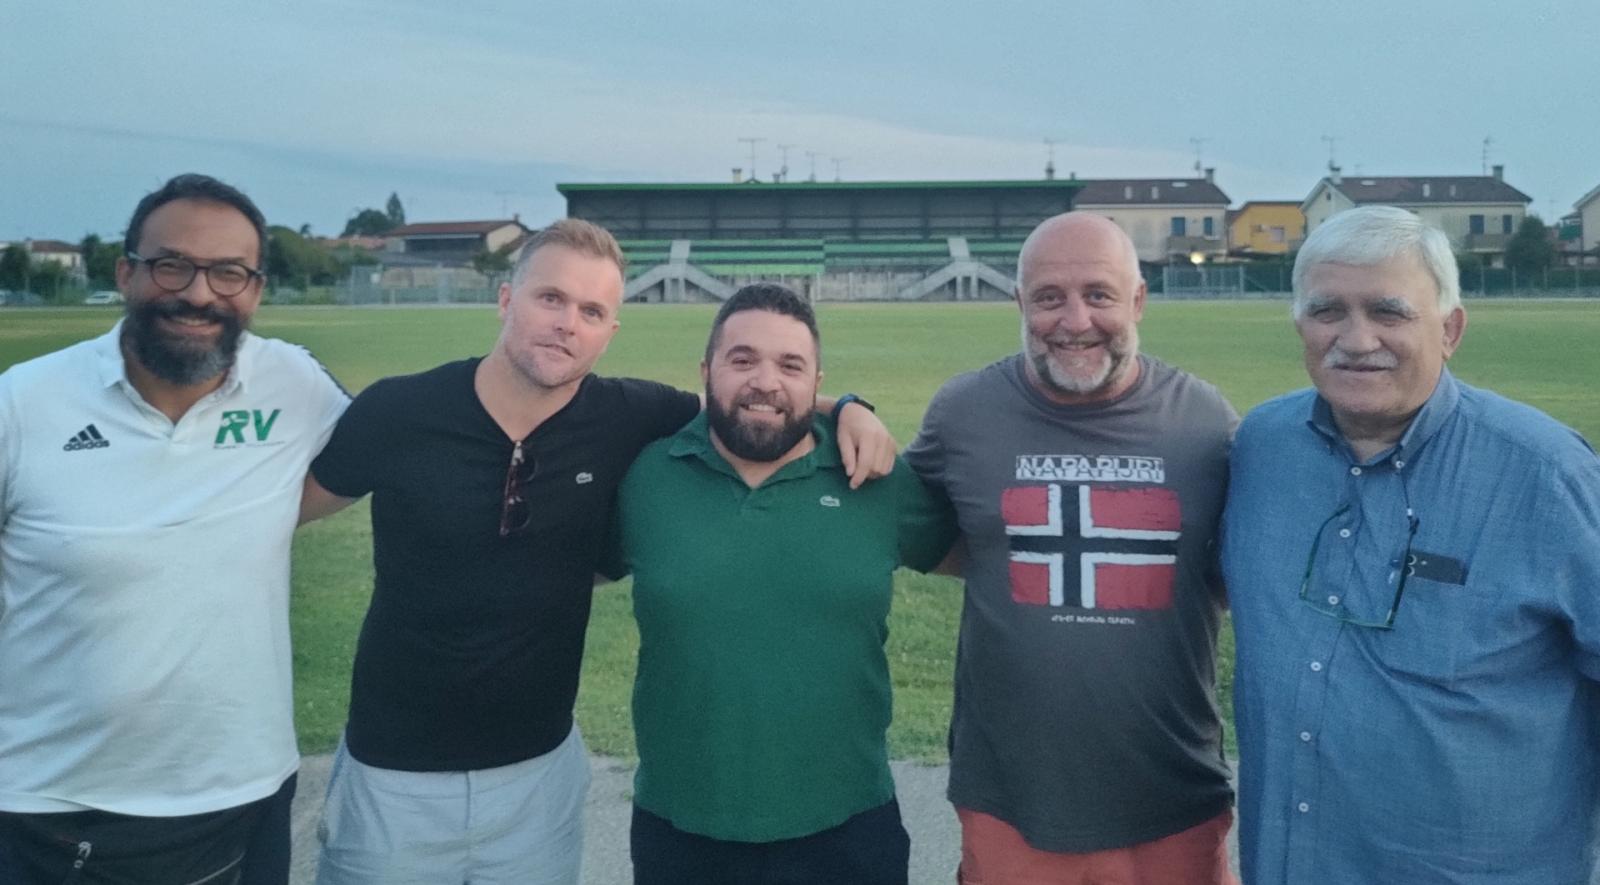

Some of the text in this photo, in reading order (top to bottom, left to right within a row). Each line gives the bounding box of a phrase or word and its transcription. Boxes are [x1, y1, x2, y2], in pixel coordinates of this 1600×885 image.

[214, 408, 282, 444] RV
[63, 439, 110, 451] adidas
[1019, 456, 1162, 481] NAPAPIJRI
